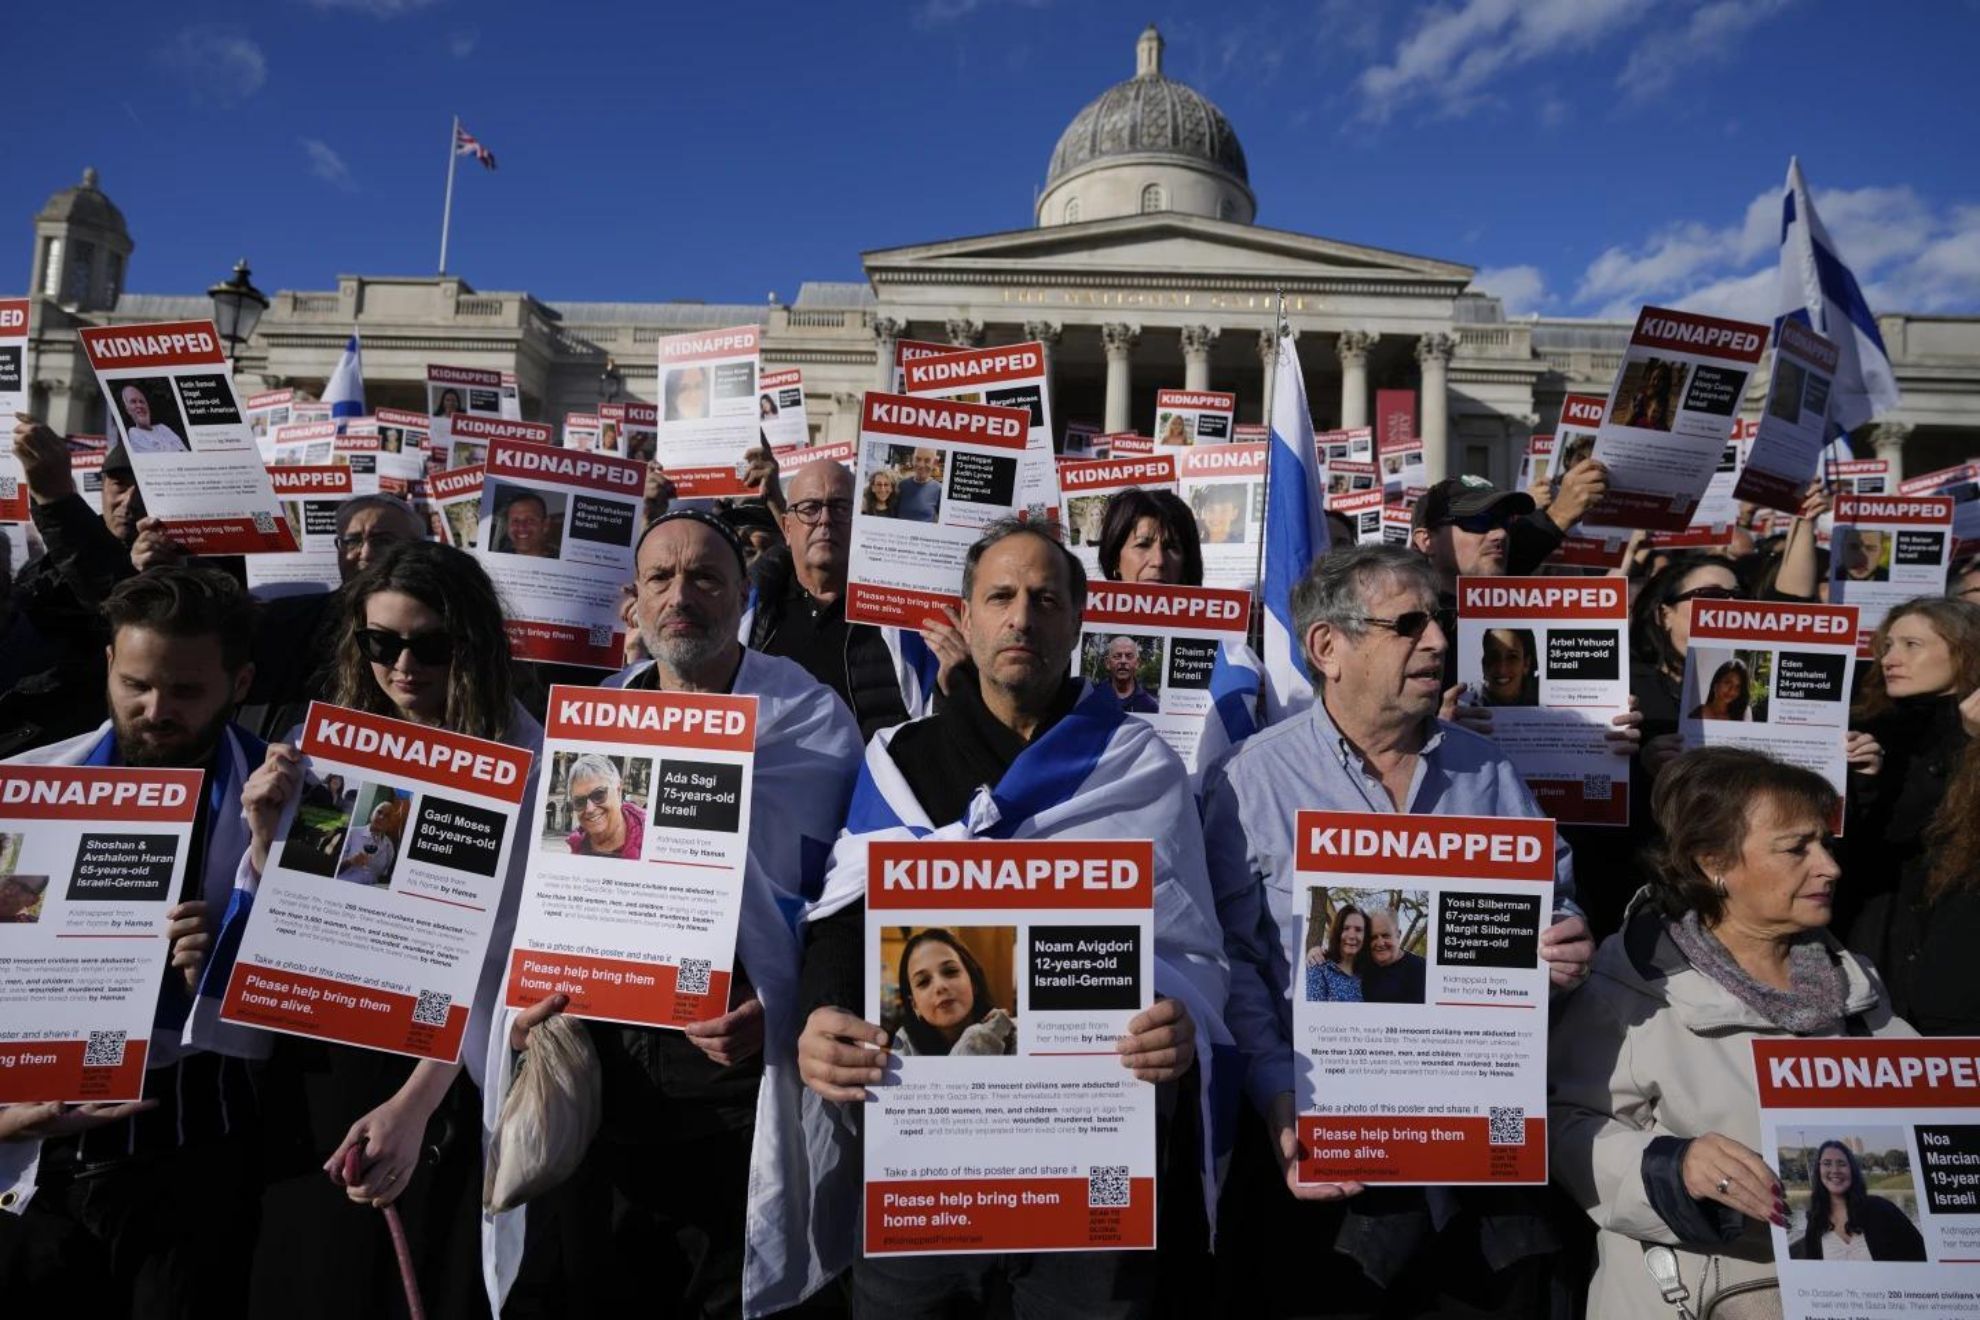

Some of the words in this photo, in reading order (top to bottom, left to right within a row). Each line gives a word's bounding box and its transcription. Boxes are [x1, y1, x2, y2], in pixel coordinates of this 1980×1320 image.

[1641, 317, 1760, 352] KIDNAPPED
[90, 332, 215, 357] KIDNAPPED
[664, 333, 755, 356] KIDNAPPED
[912, 352, 1037, 383] KIDNAPPED
[431, 368, 498, 383] KIDNAPPED
[1162, 394, 1230, 407] KIDNAPPED
[871, 402, 1020, 438] KIDNAPPED
[457, 418, 547, 441] KIDNAPPED
[779, 446, 848, 467] KIDNAPPED
[494, 447, 639, 486] KIDNAPPED
[1065, 462, 1170, 485] KIDNAPPED
[1840, 502, 1946, 517] KIDNAPPED
[857, 590, 884, 600] Please
[885, 594, 905, 606] help
[906, 597, 929, 609] bring
[1466, 587, 1617, 607] KIDNAPPED
[856, 601, 880, 610] home
[1086, 592, 1240, 620] KIDNAPPED
[1697, 609, 1849, 635] KIDNAPPED
[1550, 638, 1575, 646] Arbel
[1550, 661, 1578, 669] Israeli
[1781, 660, 1803, 668] Eden
[1173, 671, 1201, 680] Israeli
[1780, 679, 1831, 689] 24-years-old
[558, 700, 747, 736] KIDNAPPED
[314, 717, 519, 786] KIDNAPPED
[663, 771, 688, 784] Ada
[689, 773, 716, 789] Sagi
[0, 779, 187, 807] DNAPPED
[662, 787, 735, 805] 75-years-old
[660, 804, 697, 817] Israeli
[423, 808, 452, 824] Gadi
[453, 815, 491, 833] Moses
[418, 822, 496, 851] 80-years-old
[86, 840, 135, 850] Shoshan
[138, 841, 146, 850] &
[415, 837, 453, 855] Israeli
[1310, 827, 1541, 863] KIDNAPPED
[83, 853, 138, 862] Avshalom
[141, 854, 174, 863] Haran
[80, 866, 149, 876] 65-years-old
[883, 859, 1138, 889] KIDNAPPED
[77, 878, 159, 888] Israeli-German
[1446, 898, 1474, 908] Yossi
[1478, 899, 1530, 910] Silberman
[1445, 911, 1510, 922] 67-years-old
[1445, 924, 1477, 935] Margit
[1481, 925, 1533, 935] Silberman
[1035, 939, 1073, 952] Noam
[1077, 939, 1133, 956] Avigdori
[1445, 936, 1509, 948] 63-years-old
[1444, 949, 1476, 959] Israeli
[1035, 957, 1117, 971] 12-years-old
[522, 961, 561, 976] Please
[562, 965, 589, 982] help
[590, 969, 622, 985] bring
[624, 972, 655, 986] them
[1035, 973, 1132, 987] Israeli-German
[245, 974, 290, 994] Please
[290, 983, 321, 1002] help
[321, 989, 357, 1009] bring
[358, 996, 391, 1013] them
[520, 977, 552, 991] home
[555, 980, 586, 995] alive.
[1487, 988, 1497, 997] by
[240, 990, 278, 1008] home
[279, 997, 315, 1015] alive.
[1081, 1034, 1092, 1043] by
[19, 1052, 57, 1065] them
[1769, 1056, 1980, 1089] KIDNAPPE
[1081, 1081, 1120, 1089] abducted
[885, 1107, 905, 1115] More
[907, 1107, 926, 1115] than
[1313, 1102, 1334, 1112] Take
[1335, 1104, 1342, 1112] a
[1344, 1103, 1367, 1115] photo
[1369, 1103, 1379, 1112] of
[1380, 1103, 1396, 1112] this
[1398, 1104, 1425, 1115] poster
[1428, 1103, 1444, 1113] and
[1446, 1104, 1468, 1113] share
[1470, 1104, 1478, 1113] it
[1313, 1127, 1356, 1140] Please
[1360, 1128, 1389, 1143] help
[1392, 1128, 1427, 1143] bring
[1430, 1129, 1464, 1141] them
[1923, 1132, 1950, 1145] Noa
[1313, 1146, 1350, 1158] home
[1354, 1145, 1388, 1159] alive.
[884, 1167, 906, 1177] Take
[908, 1169, 916, 1177] a
[919, 1166, 947, 1179] photo
[949, 1166, 960, 1176] of
[962, 1165, 980, 1176] this
[983, 1166, 1014, 1178] poster
[1017, 1165, 1037, 1175] and
[1040, 1164, 1065, 1175] share
[1068, 1164, 1077, 1174] it
[883, 1193, 934, 1208] Please
[939, 1193, 972, 1210] help
[977, 1192, 1017, 1209] bring
[1021, 1191, 1059, 1205] them
[1934, 1191, 1976, 1205] Israeli
[883, 1213, 925, 1227] home
[931, 1212, 971, 1226] alive.
[1904, 1290, 1939, 1299] innocent
